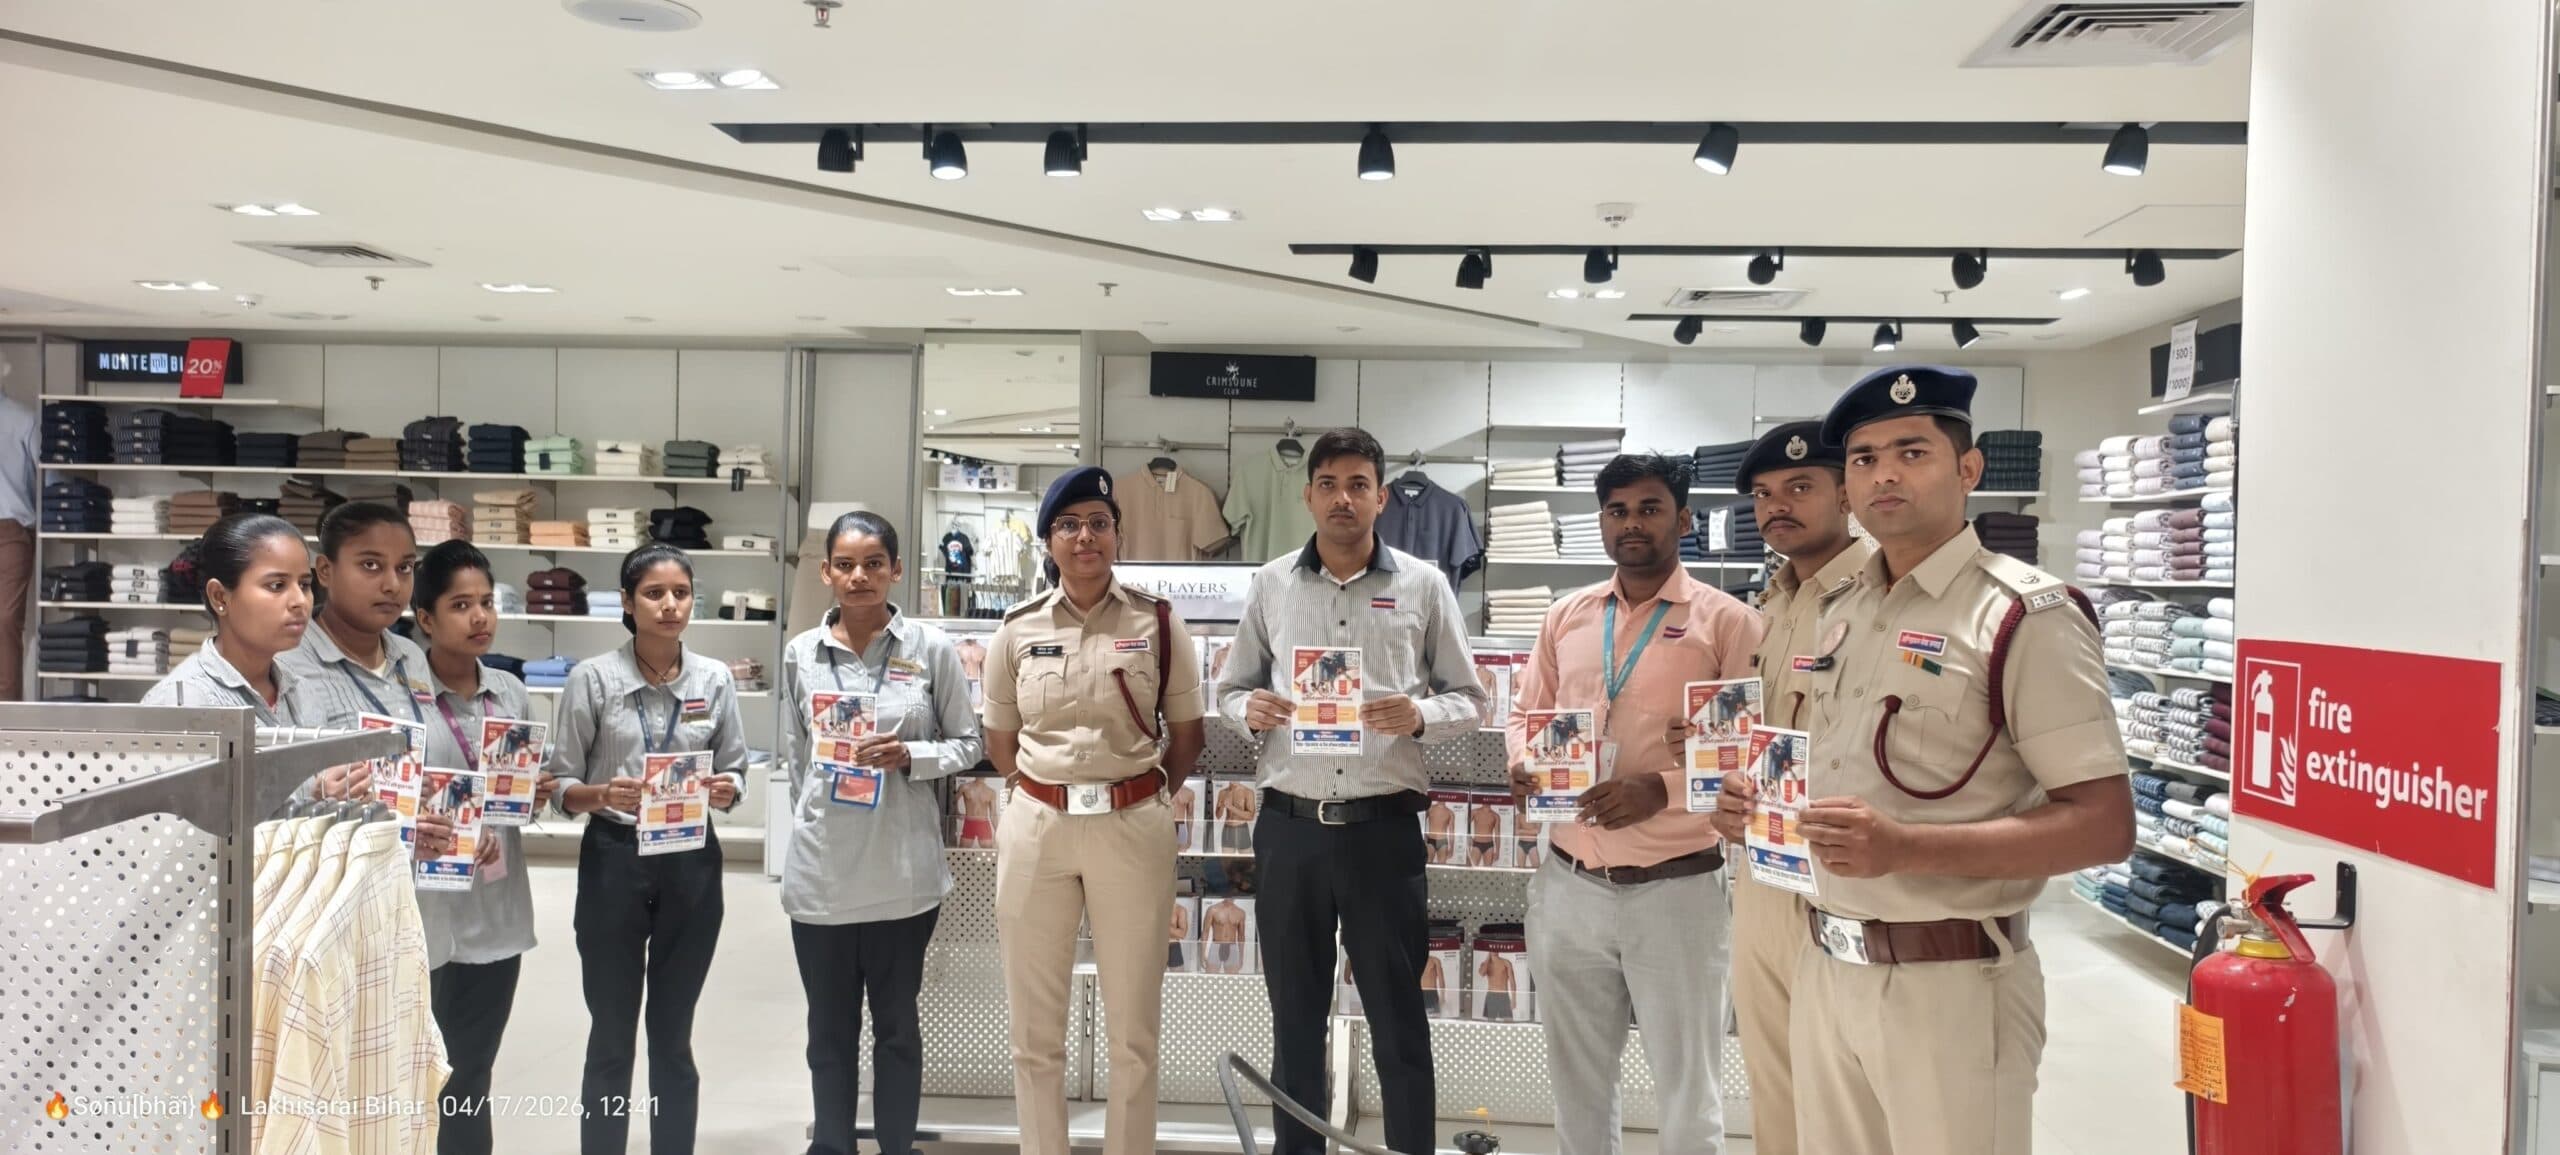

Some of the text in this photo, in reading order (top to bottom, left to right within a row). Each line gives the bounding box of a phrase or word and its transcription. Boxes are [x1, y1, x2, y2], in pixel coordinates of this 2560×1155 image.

[98, 352, 148, 371] MONTE
[1157, 580, 1228, 593] PLAYERS
[2308, 687, 2352, 734] fire
[2305, 749, 2488, 821] extinguisher
